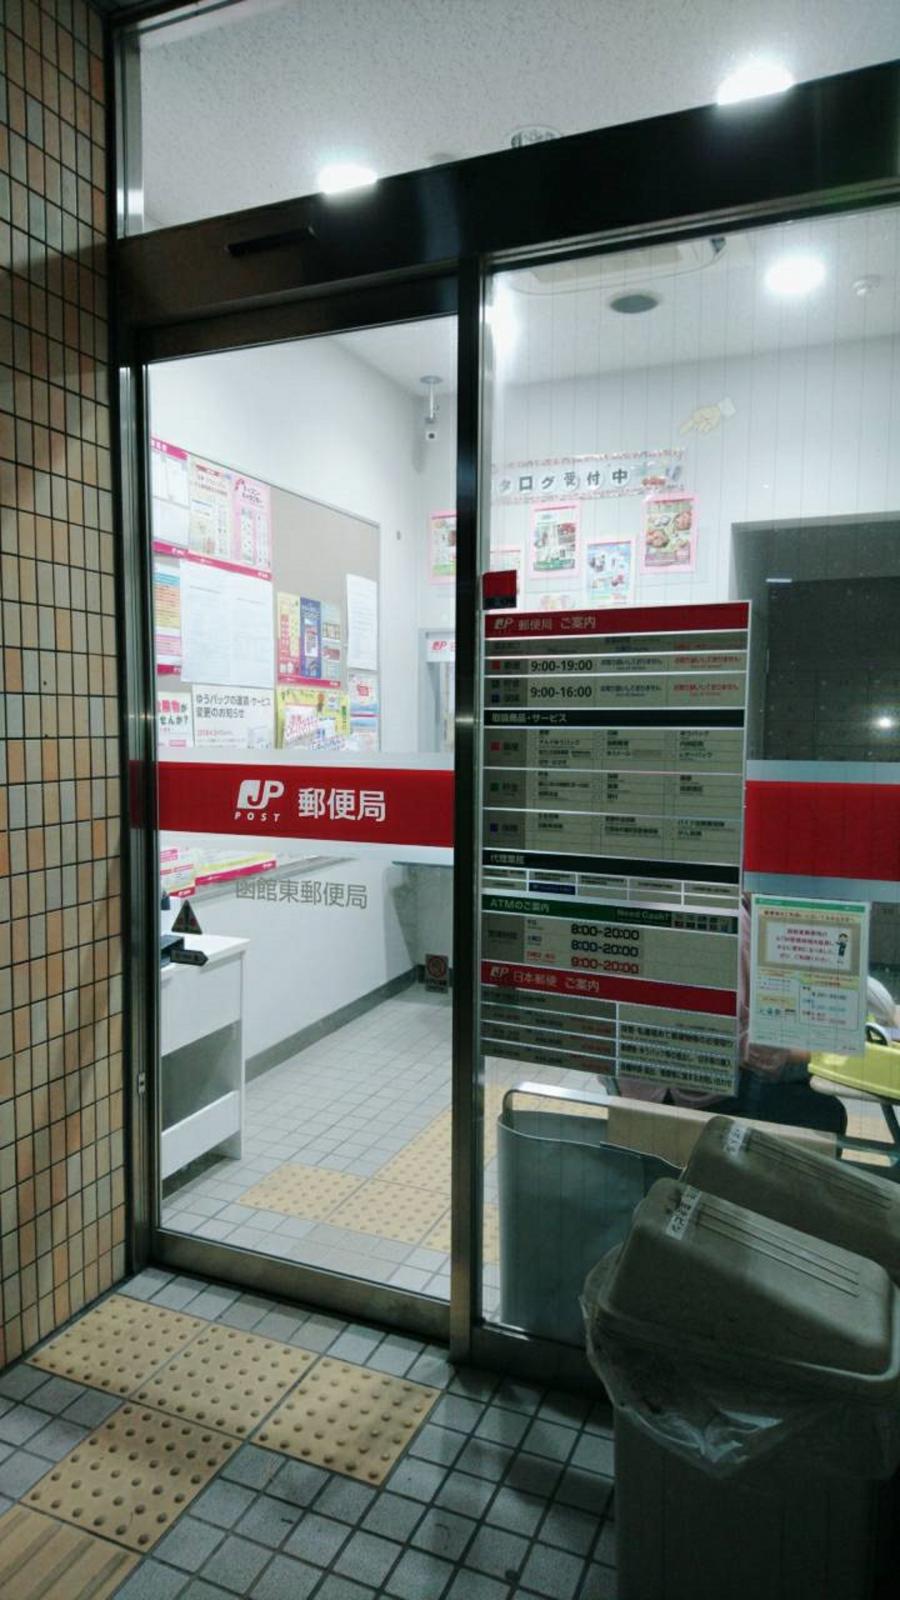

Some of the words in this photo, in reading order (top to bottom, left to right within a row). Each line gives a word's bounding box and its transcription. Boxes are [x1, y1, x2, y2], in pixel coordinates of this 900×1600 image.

[518, 617, 552, 631] 郵便局
[560, 616, 597, 630] ご案内
[530, 659, 593, 672] 9:00-19:00
[530, 685, 593, 698] 9:00-16:00
[297, 787, 387, 823] 郵便局
[234, 811, 282, 823] POST
[235, 876, 368, 910] 函館東郵便局
[571, 923, 640, 941] 8:00-20:00
[571, 939, 640, 957] 8:00-20:00
